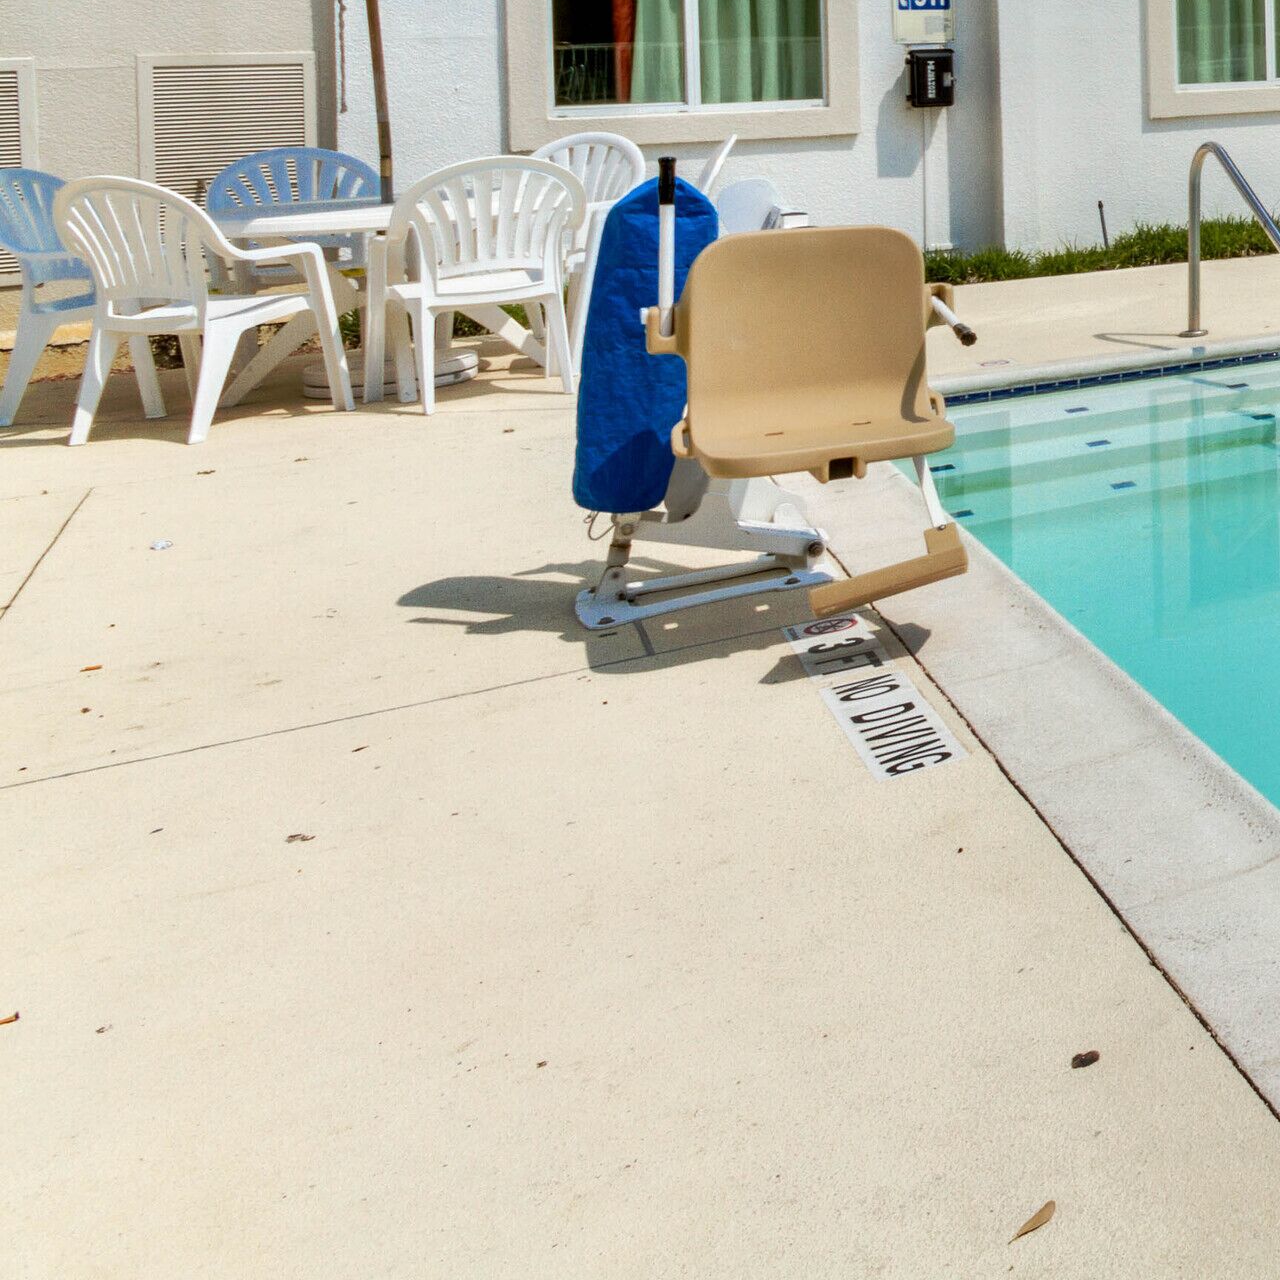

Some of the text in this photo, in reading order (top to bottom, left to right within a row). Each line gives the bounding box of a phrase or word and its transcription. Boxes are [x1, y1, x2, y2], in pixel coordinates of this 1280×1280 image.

[808, 637, 883, 675] 3 FT
[833, 674, 953, 777] NO DIVING
